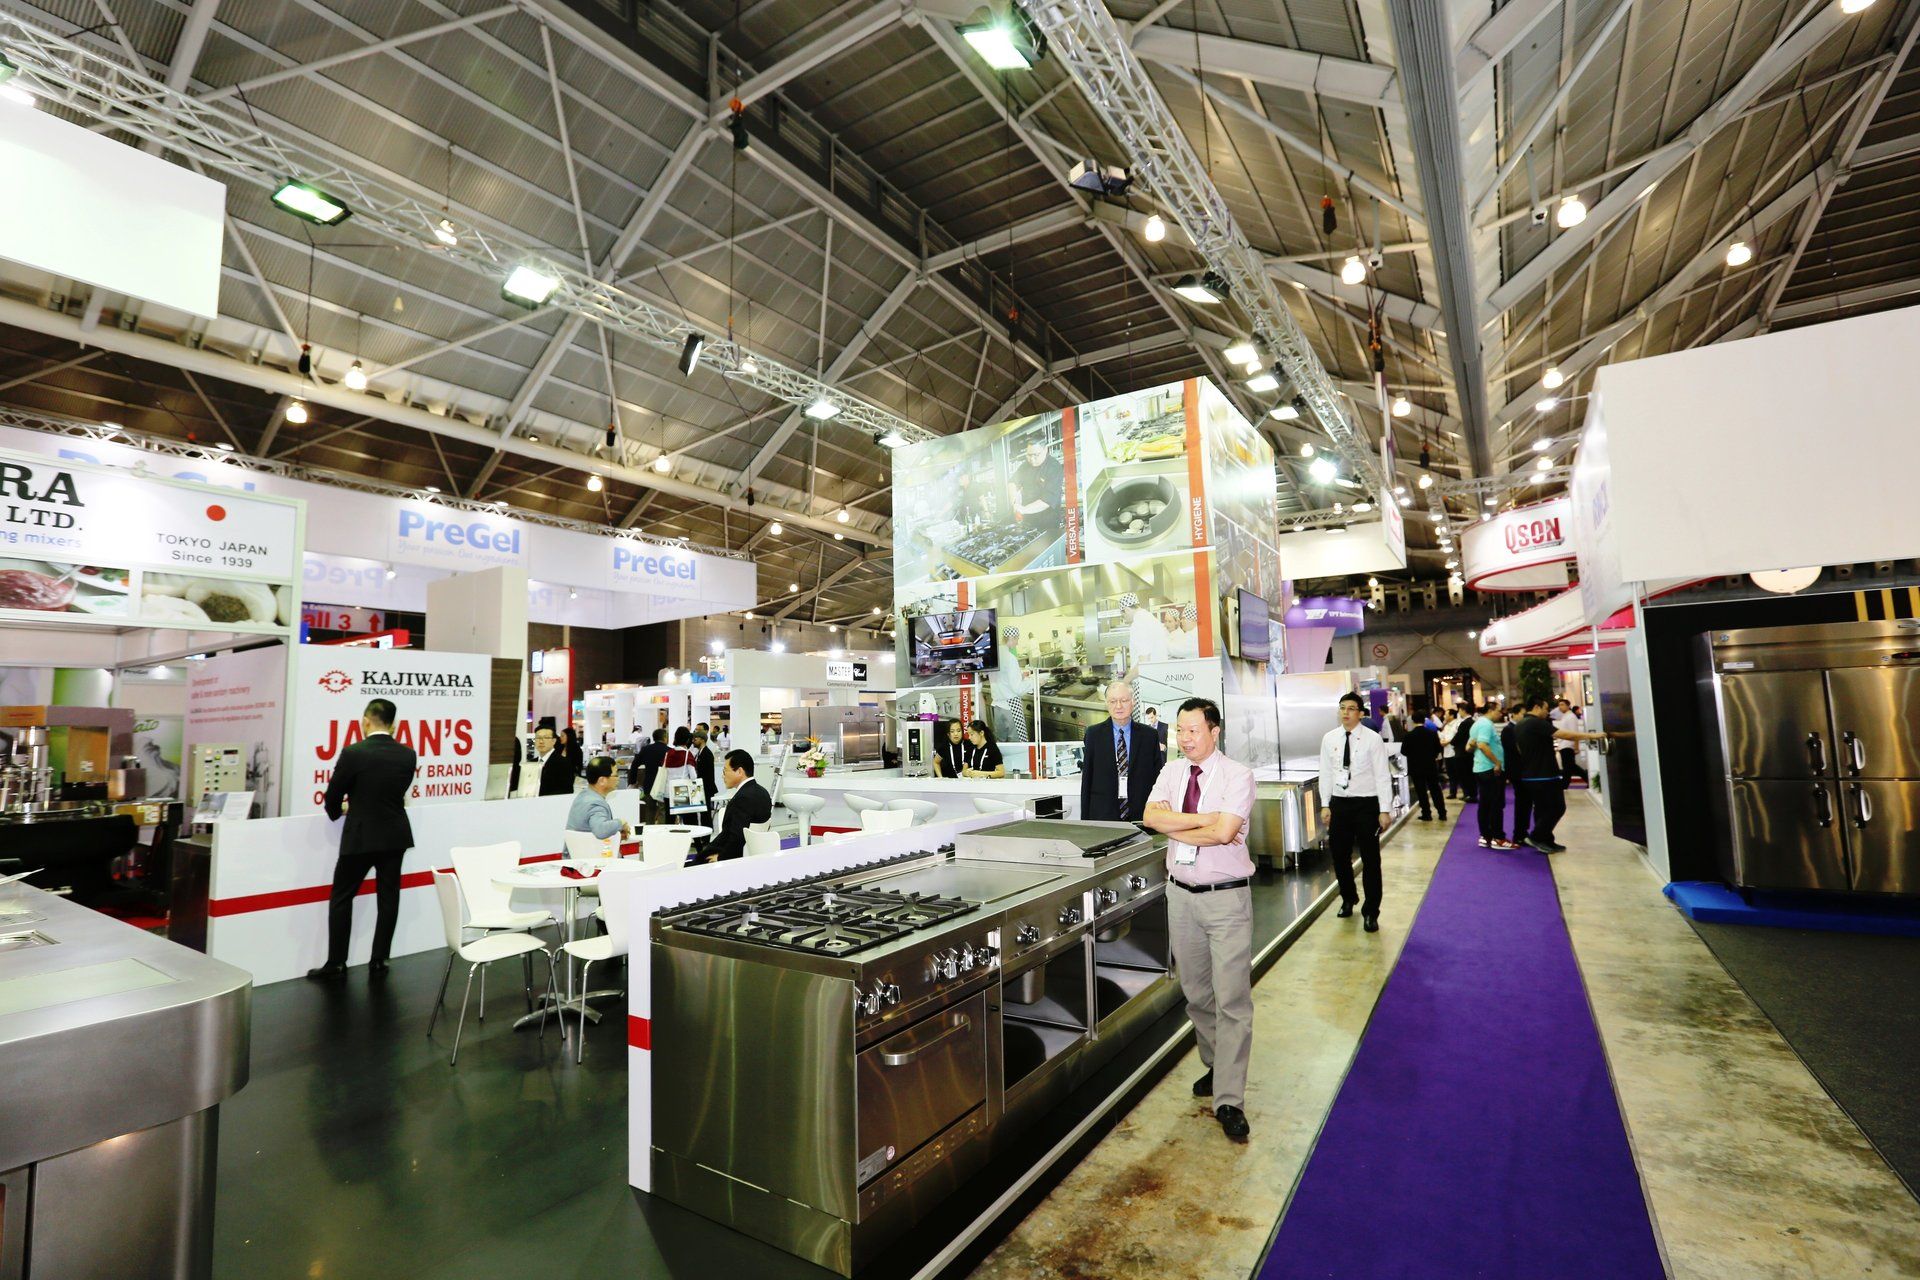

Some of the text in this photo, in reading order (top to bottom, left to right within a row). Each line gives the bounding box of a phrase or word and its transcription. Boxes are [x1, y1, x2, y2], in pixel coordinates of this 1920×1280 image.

[6, 505, 82, 531] LTD.
[1193, 497, 1204, 540] HYGIENE
[24, 533, 82, 548] mixers
[398, 509, 520, 554] PreGel
[1068, 507, 1078, 558] VERSATILE
[1504, 517, 1561, 555] QSON
[157, 533, 268, 556] TOKYO JAPAN
[171, 550, 253, 568] Since 1939
[613, 547, 696, 580] PreGel
[338, 614, 352, 631] 3
[361, 671, 475, 688] KAJIWARA
[1165, 673, 1195, 682] ANIMO
[360, 687, 474, 698] SINGAPORE PTE. LTD.
[315, 719, 473, 761] JAAN'S
[427, 763, 472, 778] BRAND
[411, 781, 472, 798] & MIXING
